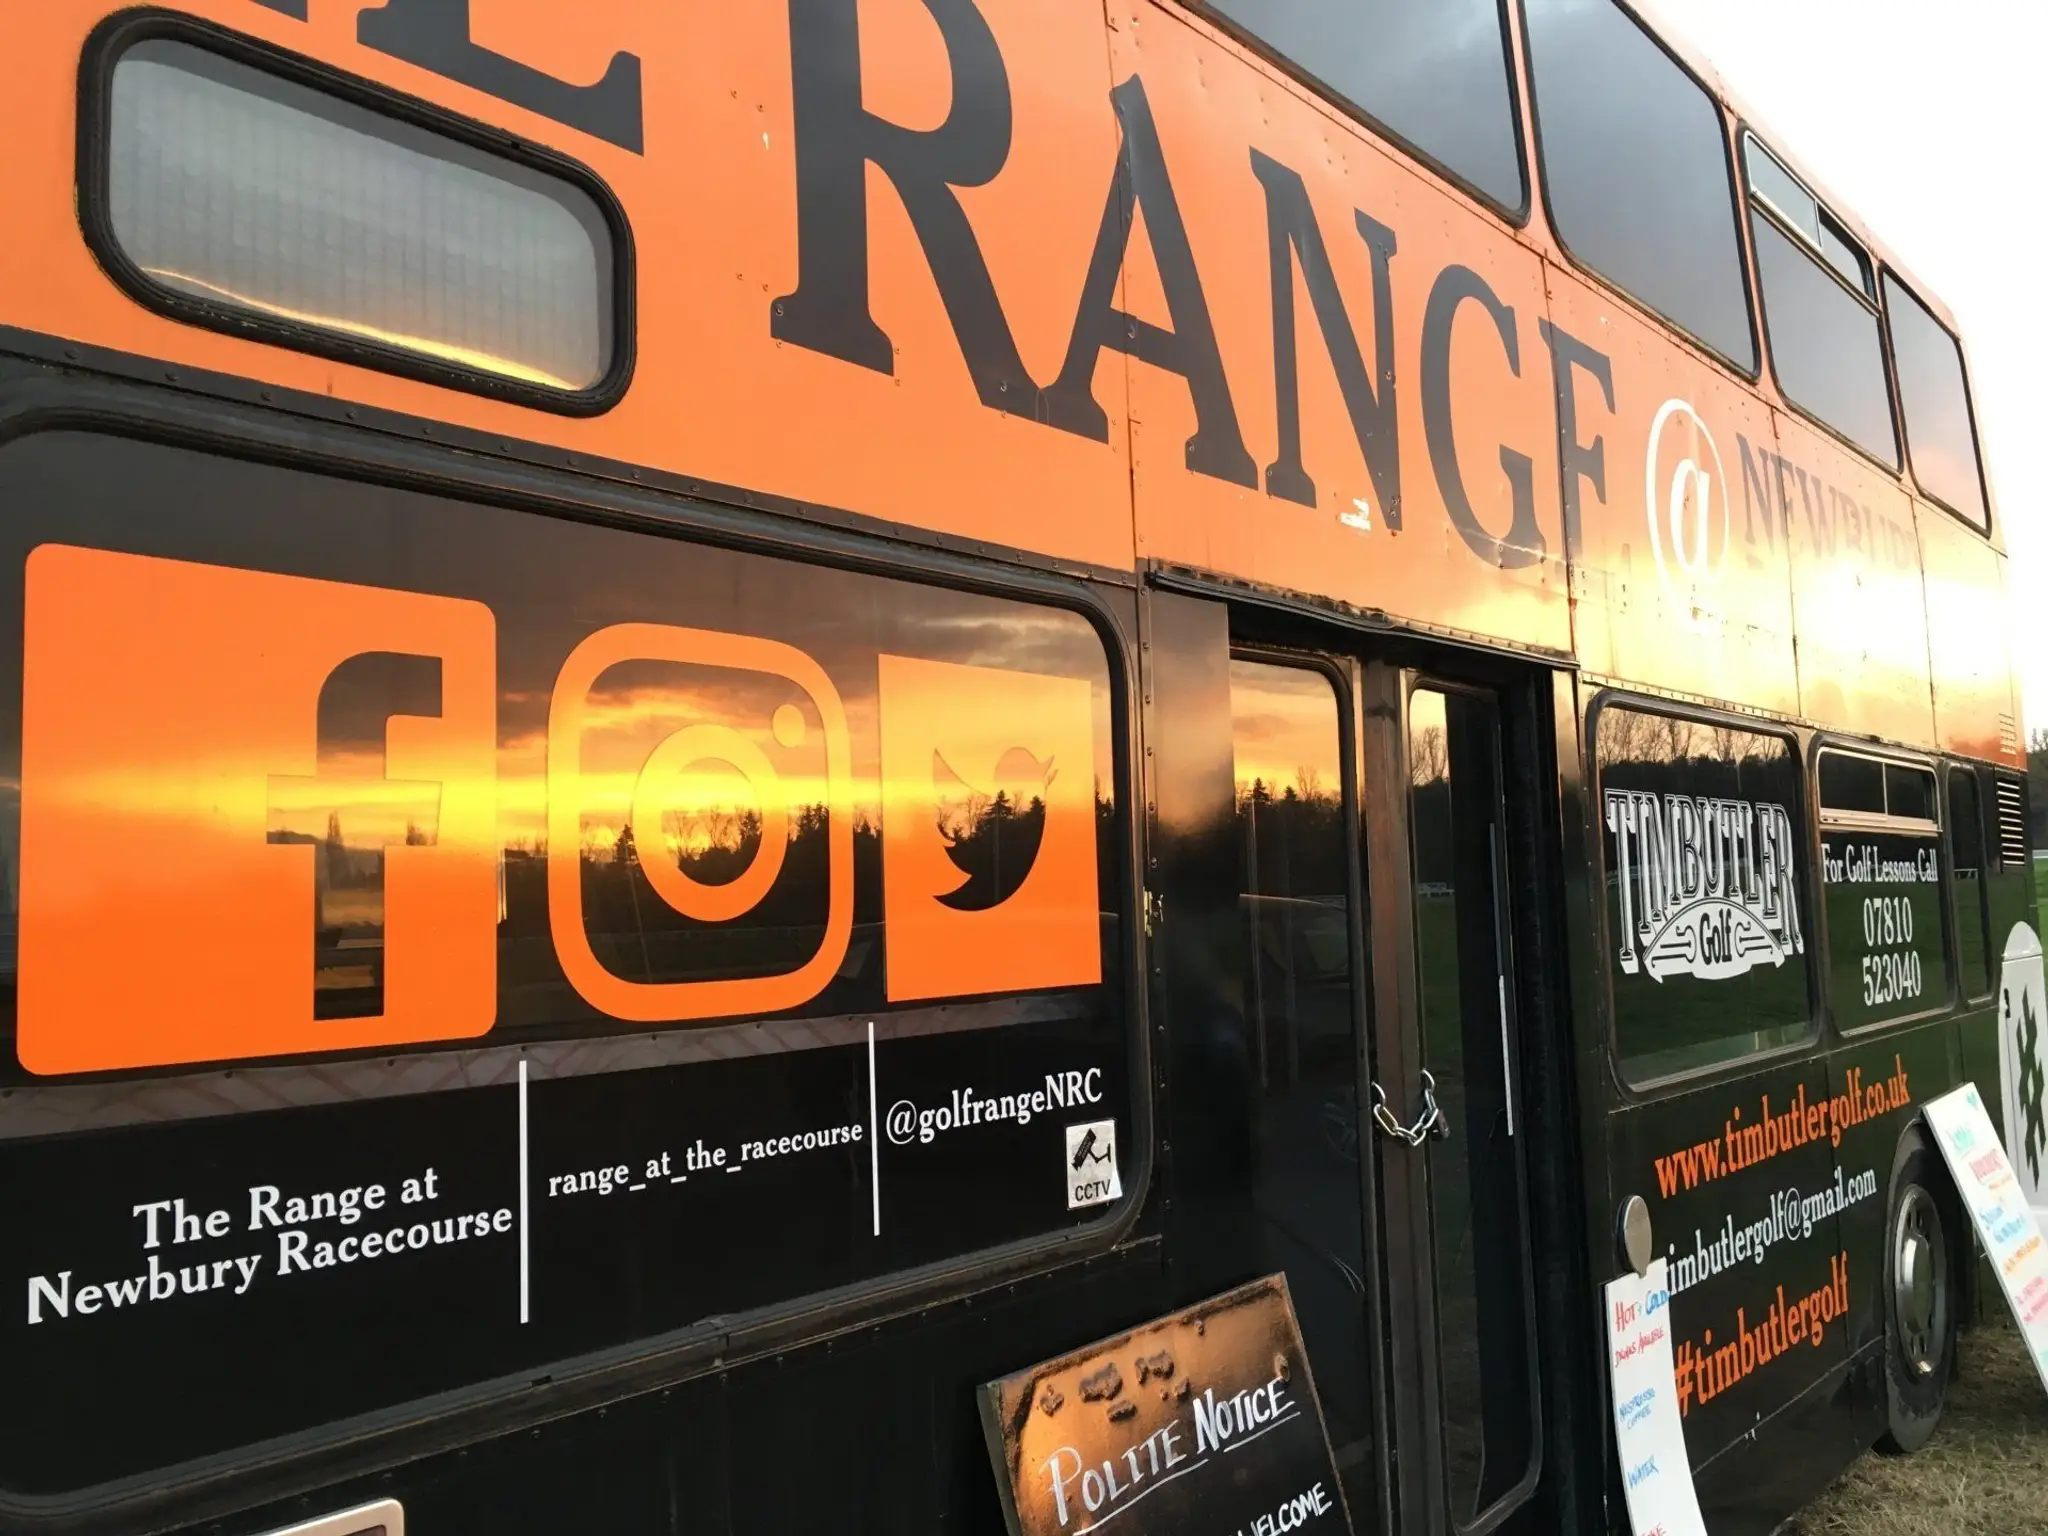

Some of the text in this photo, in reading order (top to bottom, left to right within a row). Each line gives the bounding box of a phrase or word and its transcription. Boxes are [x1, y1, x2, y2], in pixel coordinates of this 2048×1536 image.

[770, 0, 1630, 573] RANGE
[1821, 843, 1938, 883] For Golf Lessons Call
[1700, 908, 1732, 965] Golf
[1863, 896, 1913, 947] 07810
[1863, 950, 1921, 1006] 523040
[885, 1067, 1102, 1145] @golfrangeNRC
[1655, 1054, 1910, 1199] www.timbutlergolf.co.uk
[548, 1120, 863, 1197] range_at_the_racecourse
[1075, 1179, 1111, 1202] CCTV
[133, 1168, 438, 1249] The Range at
[1665, 1165, 1877, 1297] imbutlergolf@gmail.com
[27, 1208, 513, 1324] Newbury Racecourse
[1615, 1302, 1638, 1332] HOT
[1673, 1250, 1849, 1417] #timbutlergolf
[1038, 1376, 1296, 1527] POLITE NOTICE
[1627, 1455, 1659, 1489] WATER
